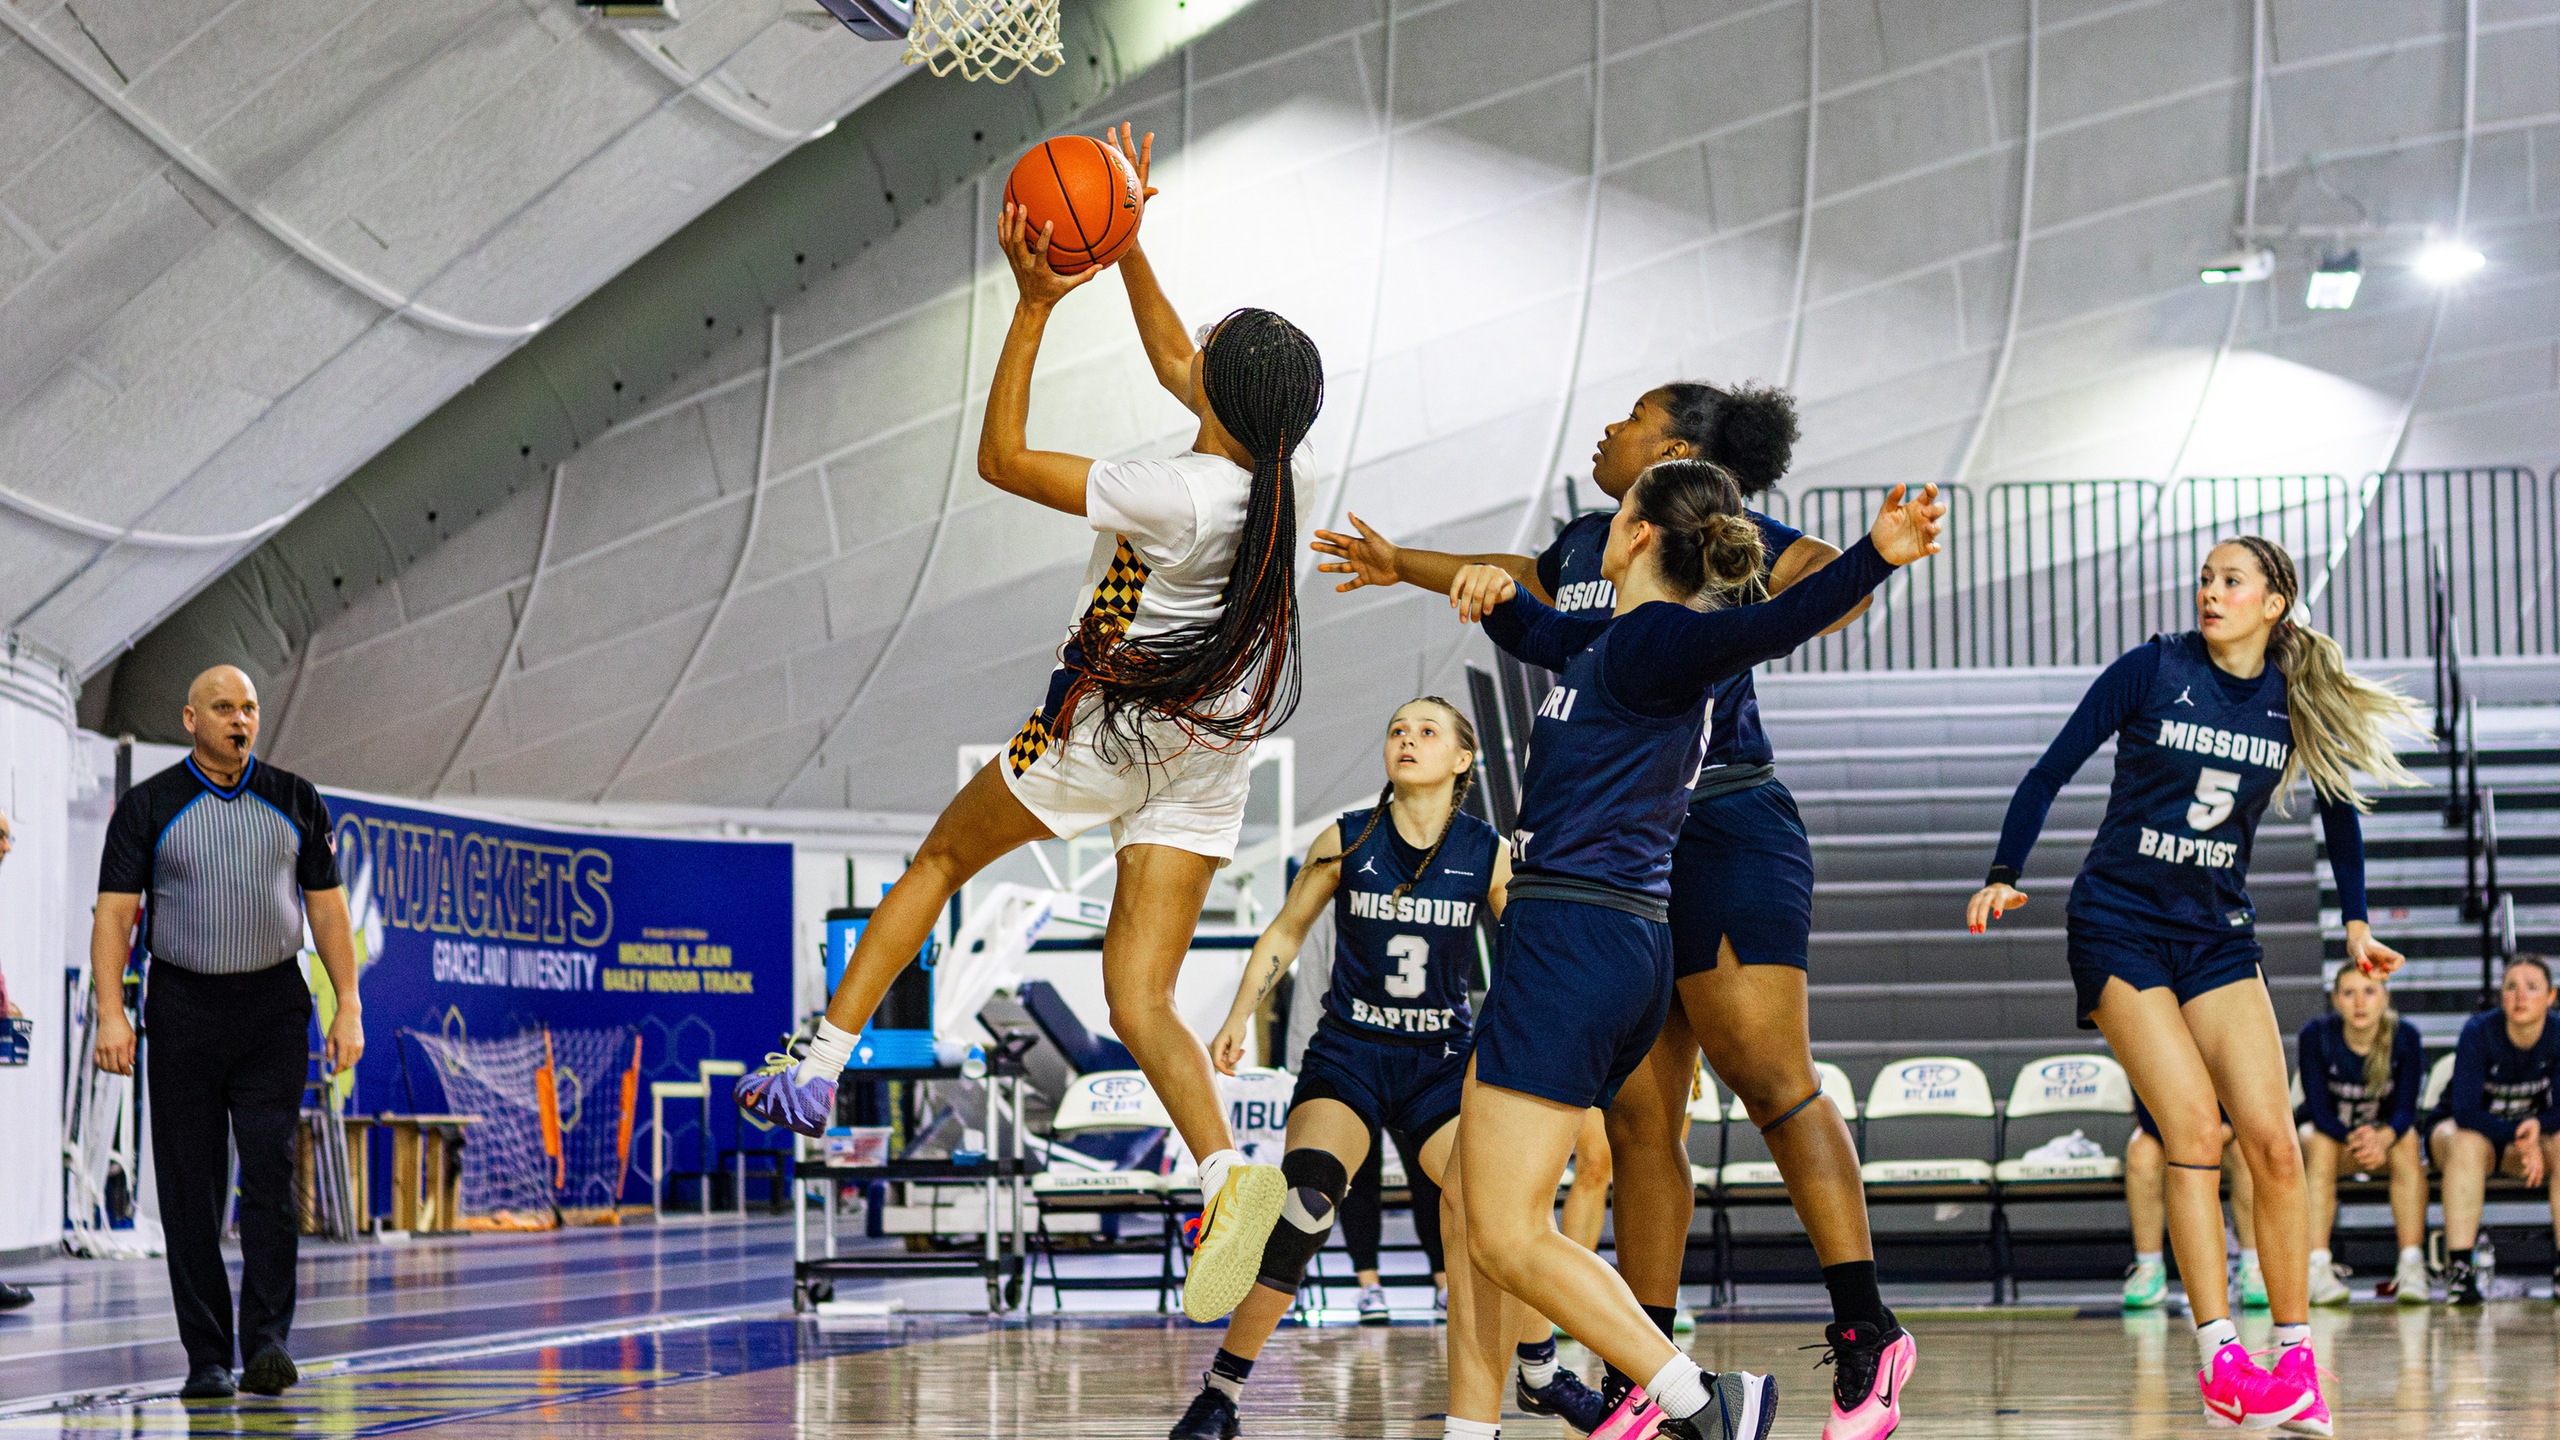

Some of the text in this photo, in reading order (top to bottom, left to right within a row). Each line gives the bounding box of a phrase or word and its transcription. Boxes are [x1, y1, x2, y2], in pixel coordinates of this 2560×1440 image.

[2156, 719, 2288, 770] MISSOURI
[2186, 766, 2242, 832] 5
[2138, 827, 2237, 868] BAPTIST
[1350, 890, 1476, 927] MISSOURI
[433, 938, 598, 992] GRACELAND UNIVERSITY
[692, 944, 732, 968] JEAN
[1384, 934, 1430, 999] 3
[702, 971, 754, 994] TRACK
[1352, 998, 1455, 1033] BAPTIST
